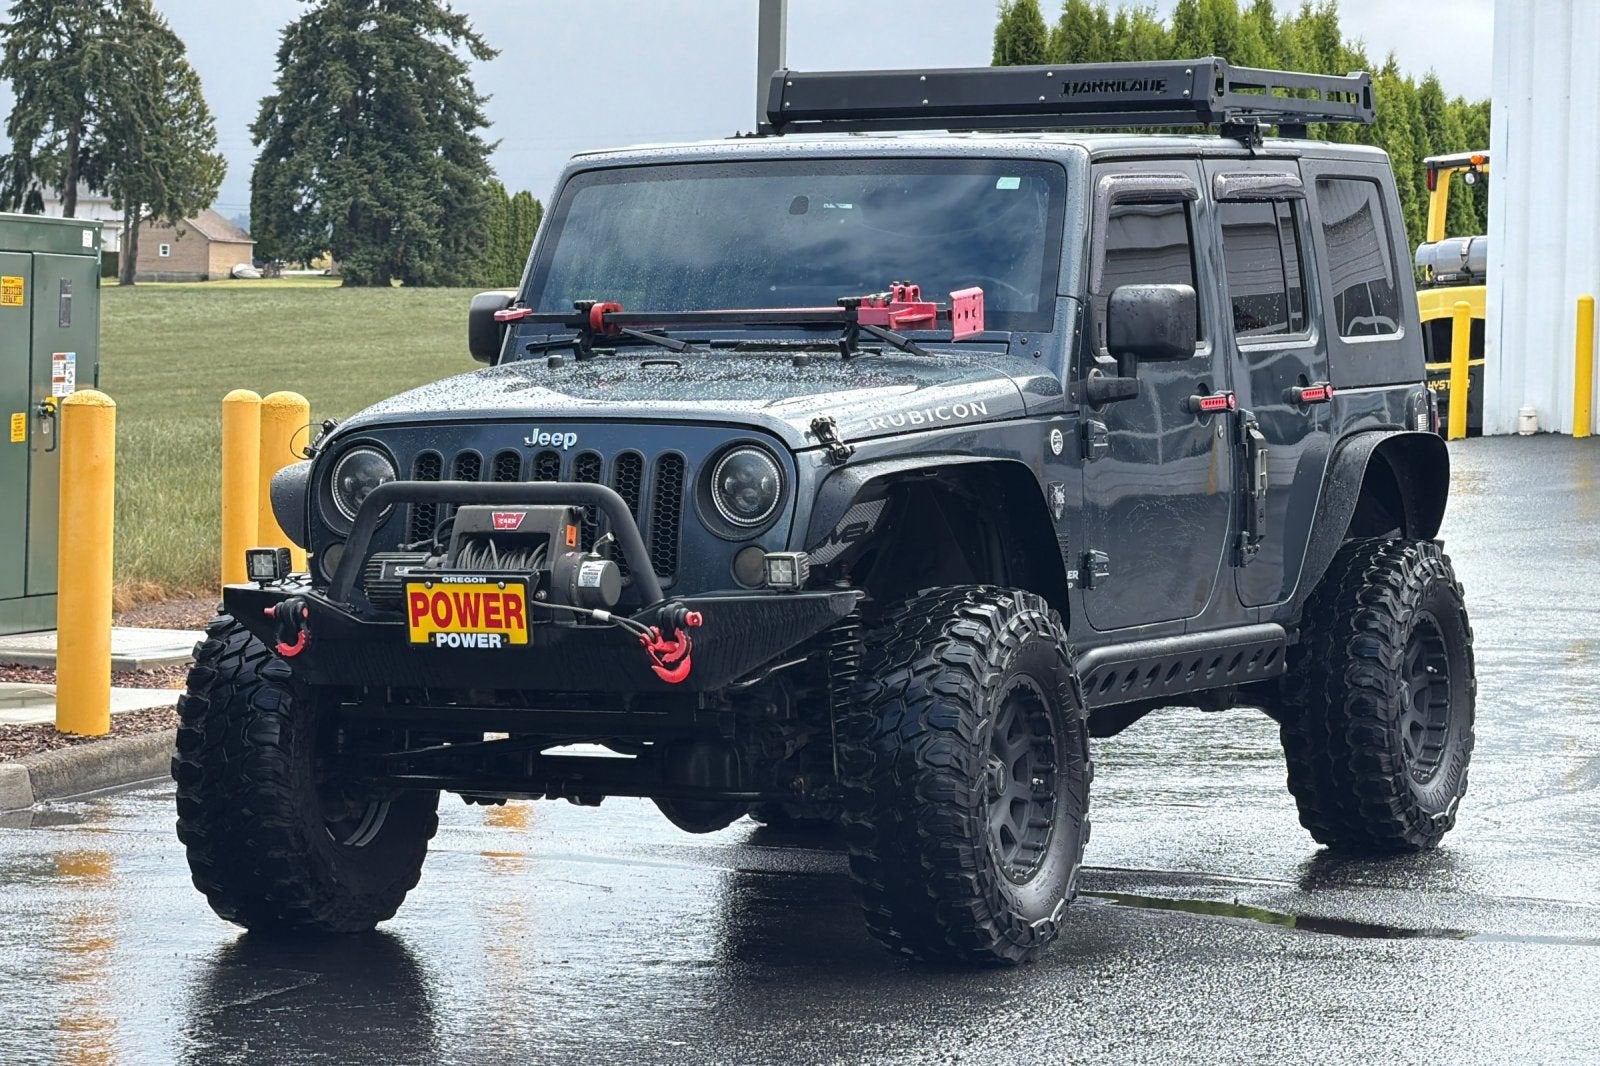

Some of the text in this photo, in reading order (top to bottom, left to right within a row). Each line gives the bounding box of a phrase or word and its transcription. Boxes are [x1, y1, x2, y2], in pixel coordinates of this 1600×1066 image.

[867, 401, 988, 430] RUBICON
[524, 428, 577, 451] Jeep
[410, 591, 525, 630] POWER
[435, 632, 502, 649] POWER
